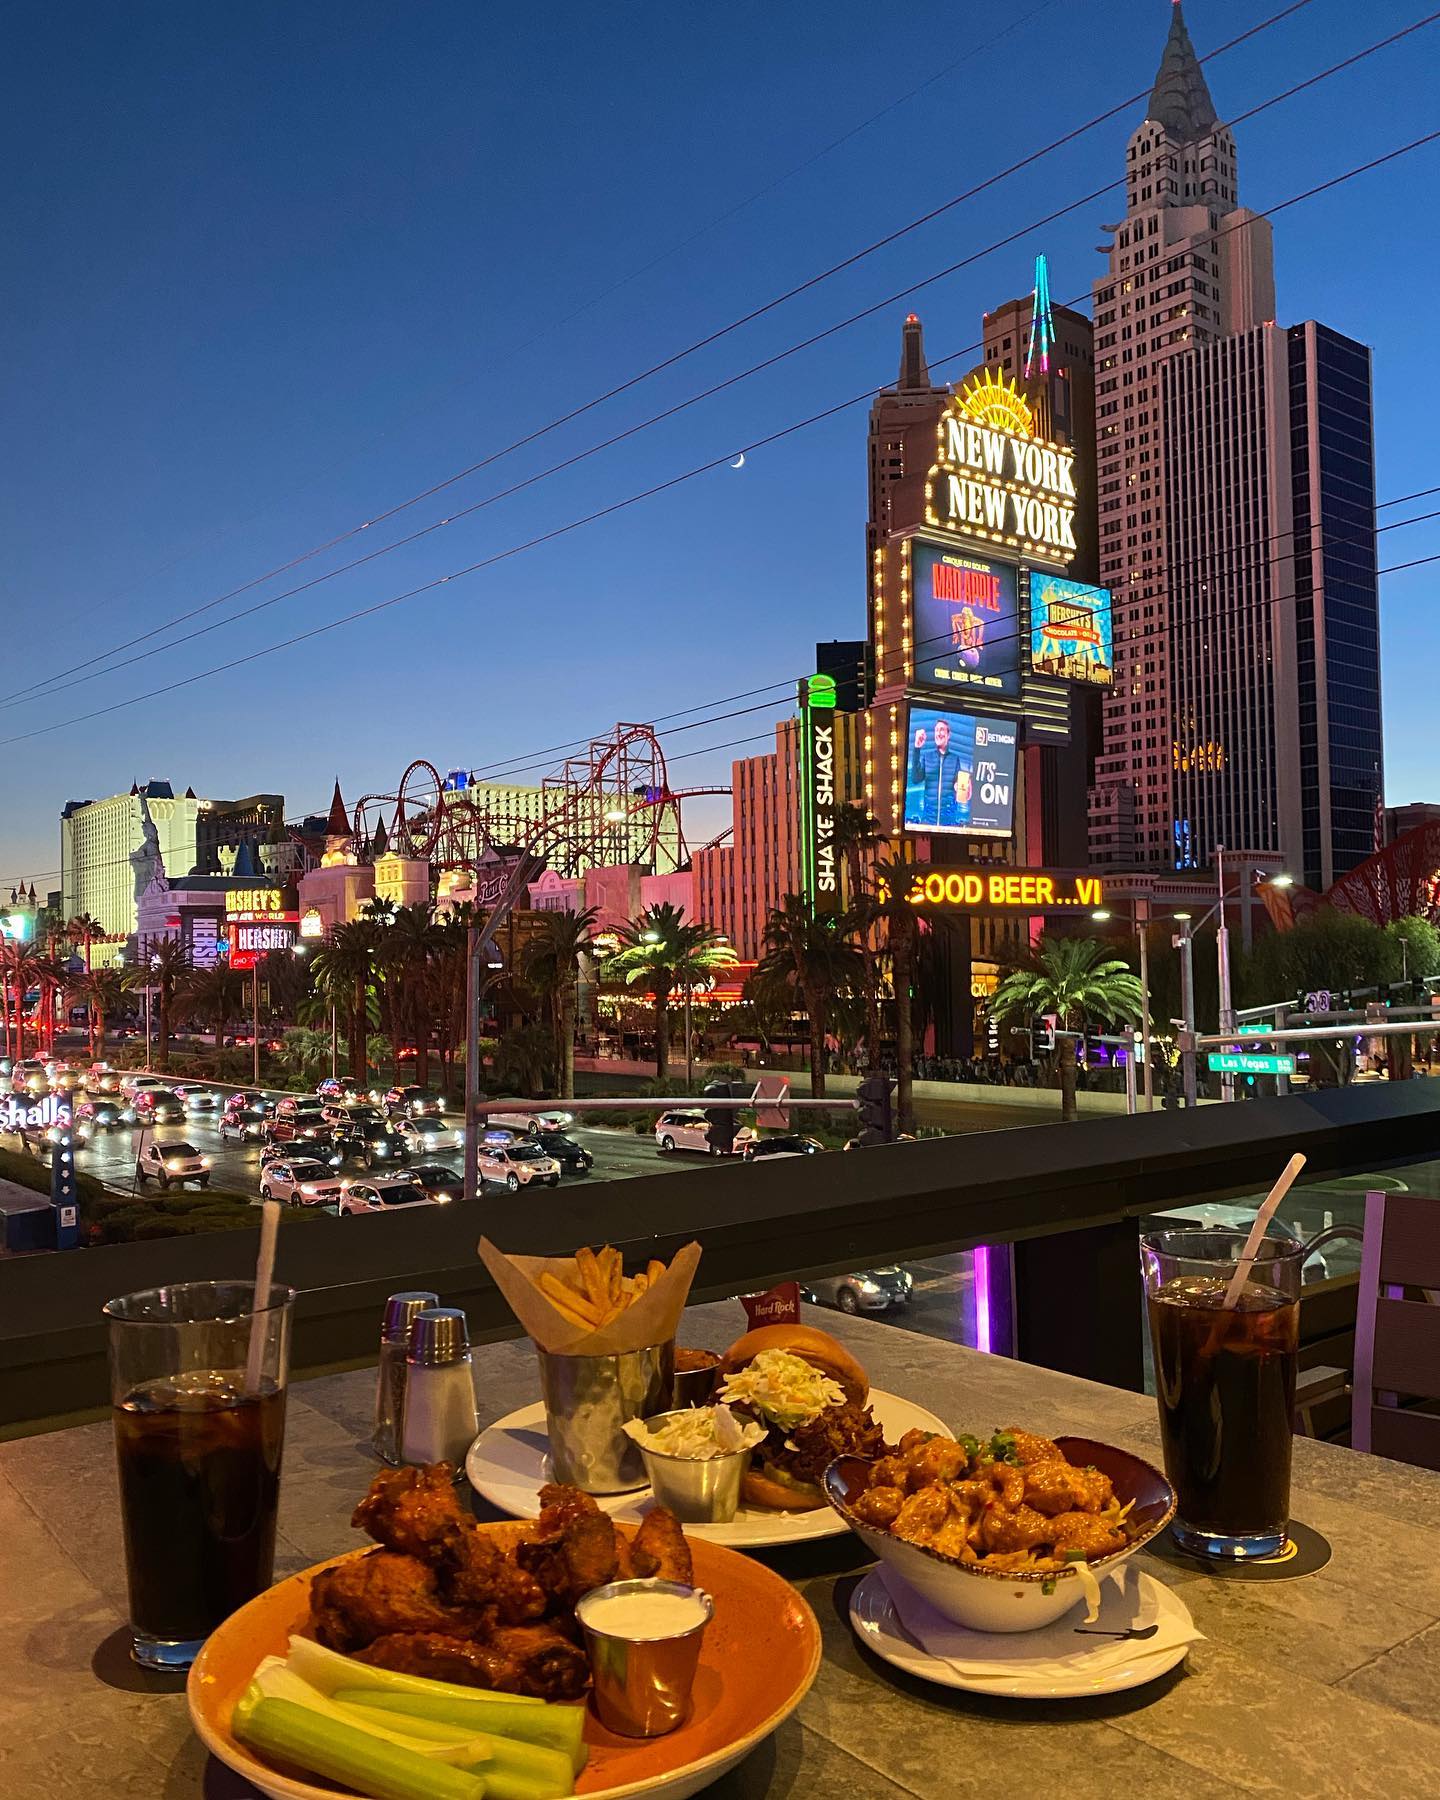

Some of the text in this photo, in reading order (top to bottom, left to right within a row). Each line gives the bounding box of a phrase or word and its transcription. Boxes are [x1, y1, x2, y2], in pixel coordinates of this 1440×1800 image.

[947, 417, 1077, 498] NEW YORK
[948, 474, 1077, 550] NEW YORK
[932, 563, 1001, 613] MAD APPLE
[815, 725, 834, 806] SHACK
[980, 783, 1009, 806] ON
[1220, 1056, 1238, 1068] Las
[1240, 1057, 1270, 1072] Vegas
[754, 1299, 796, 1317] Hard Rock
